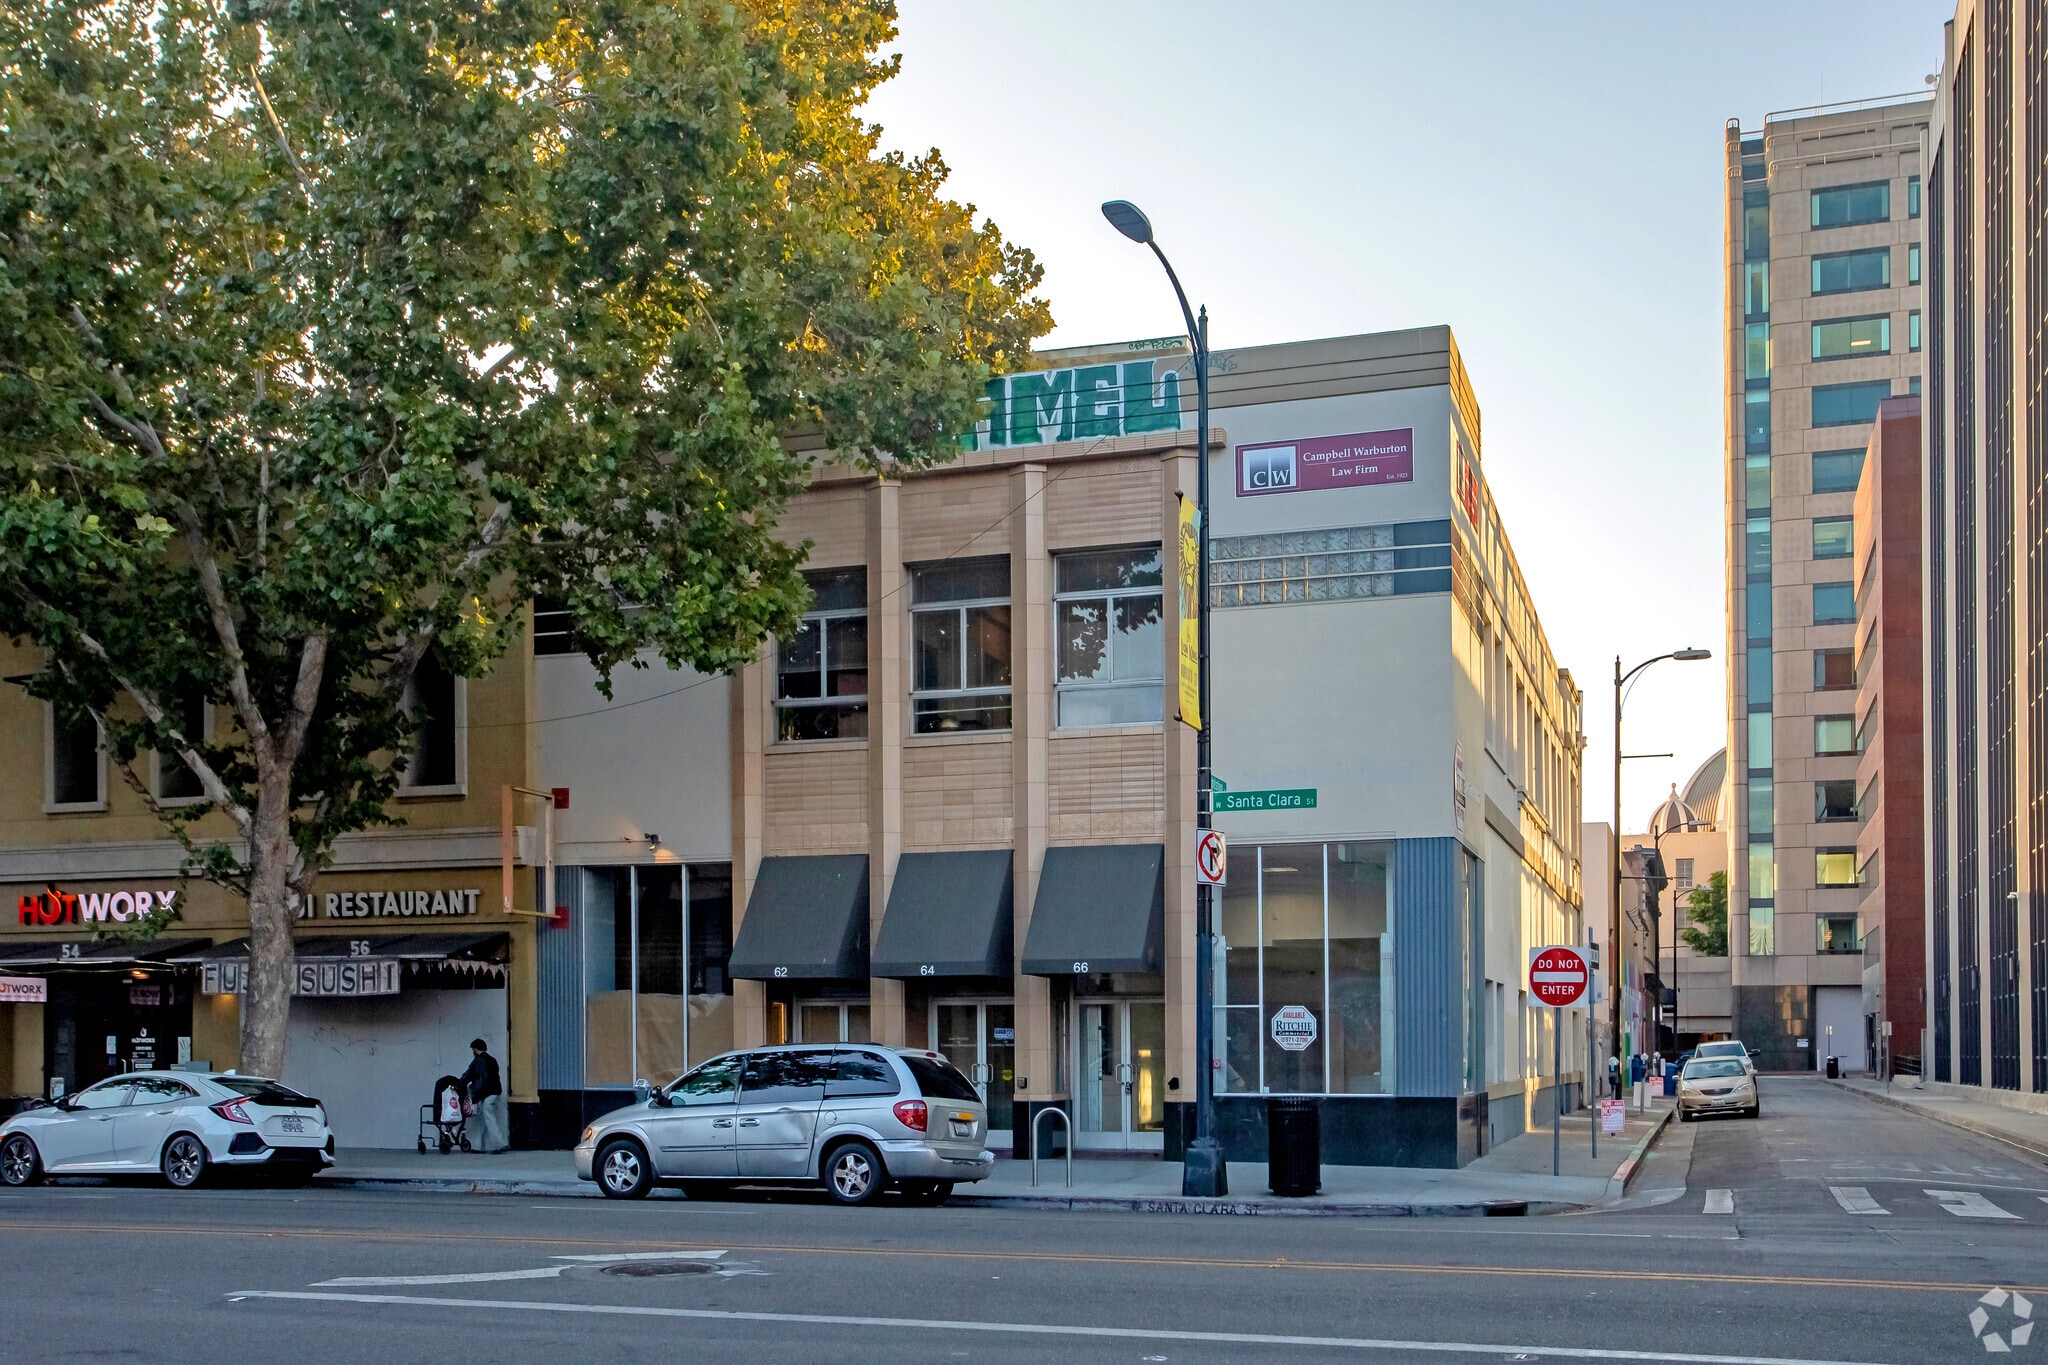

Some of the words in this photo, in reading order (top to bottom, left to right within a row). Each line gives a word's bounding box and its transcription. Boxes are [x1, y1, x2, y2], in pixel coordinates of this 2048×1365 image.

[1303, 448, 1351, 462] Campbell
[1353, 444, 1407, 457] Warburton
[1331, 467, 1353, 477] Law
[1355, 464, 1378, 475] Firm
[1227, 795, 1263, 808] Santa
[1268, 793, 1301, 807] Clara
[18, 887, 177, 925] HOTWORX
[325, 888, 480, 917] RESTAURANT
[62, 944, 80, 959] 54
[350, 941, 370, 956] 56
[920, 965, 935, 976] 64
[1073, 962, 1088, 973] 66
[1538, 960, 1553, 969] DO
[1558, 959, 1579, 969] NOT
[301, 964, 392, 993] SUSHI
[774, 967, 788, 978] 62
[1542, 985, 1575, 995] ENTER
[1148, 1202, 1188, 1214] SANTA
[1194, 1203, 1237, 1215] CLARA
[1244, 1204, 1259, 1215] ST
